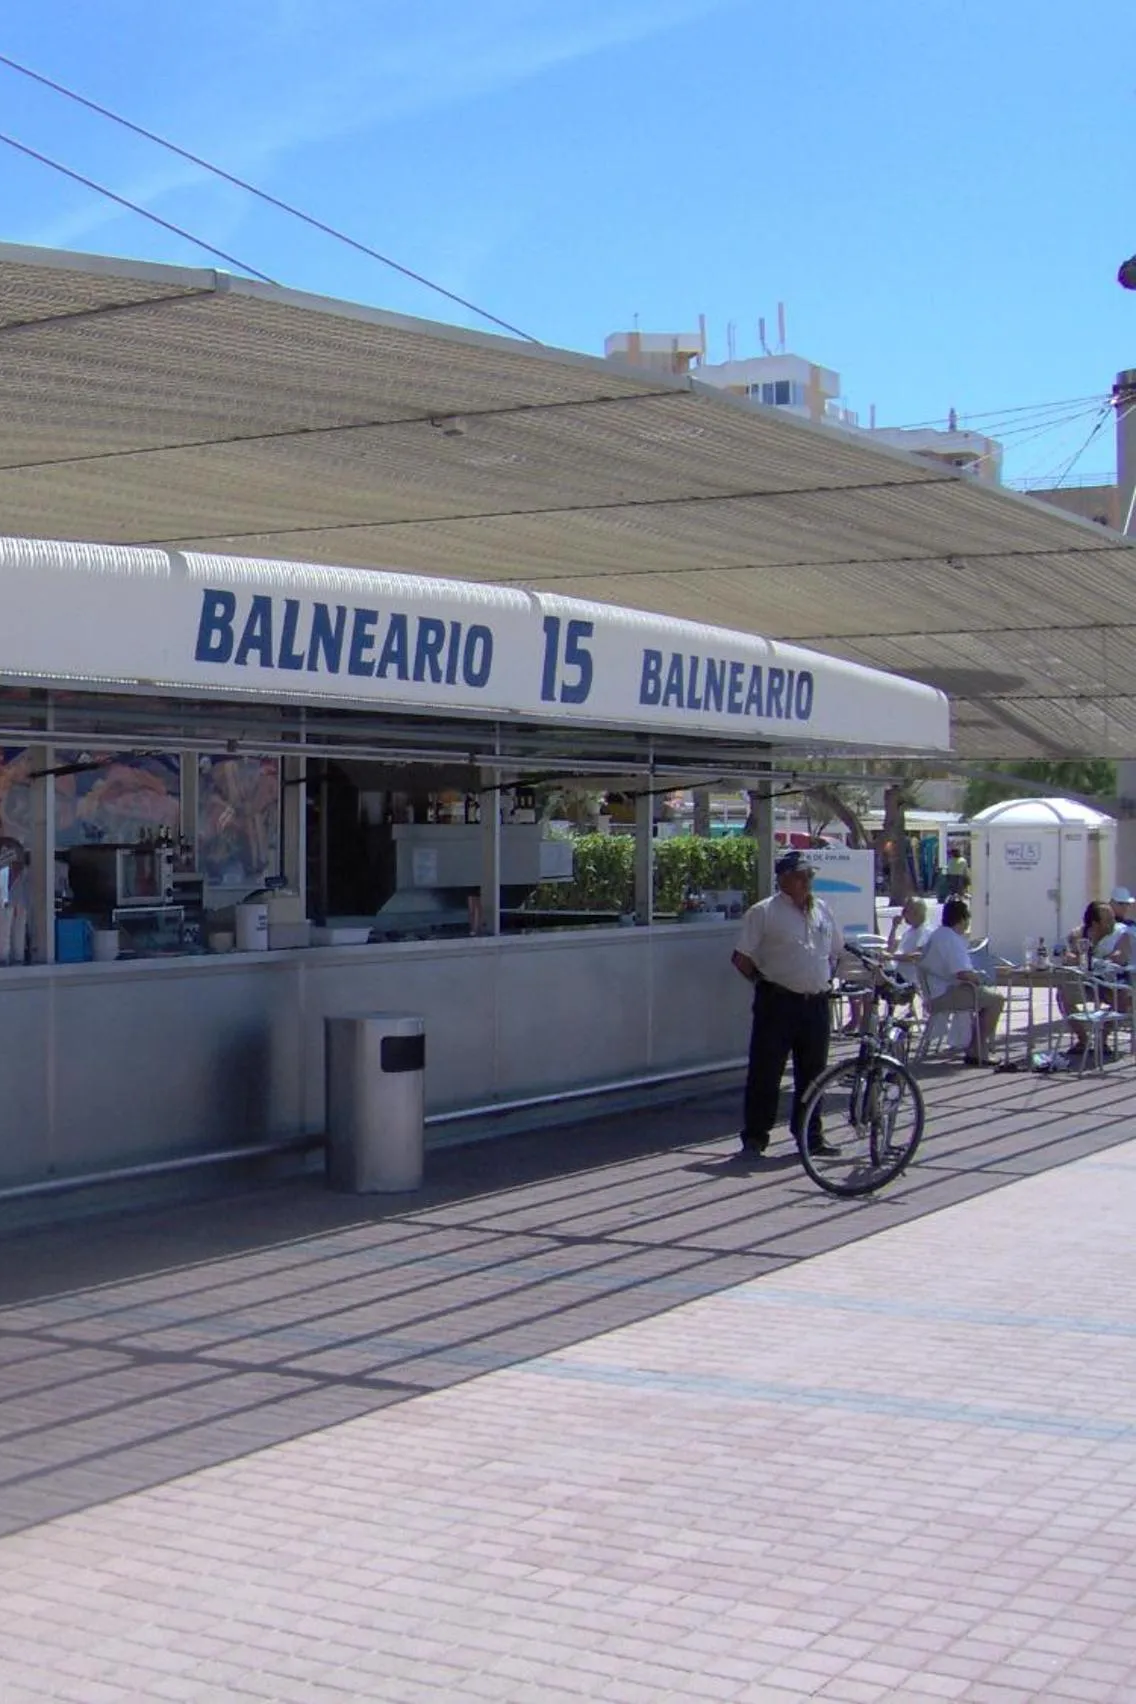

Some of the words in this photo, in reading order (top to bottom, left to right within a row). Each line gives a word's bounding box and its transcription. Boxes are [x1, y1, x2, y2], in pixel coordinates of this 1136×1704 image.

[195, 589, 492, 688] BALNEARIO
[541, 616, 593, 704] 15
[640, 650, 813, 720] BALNEARIO
